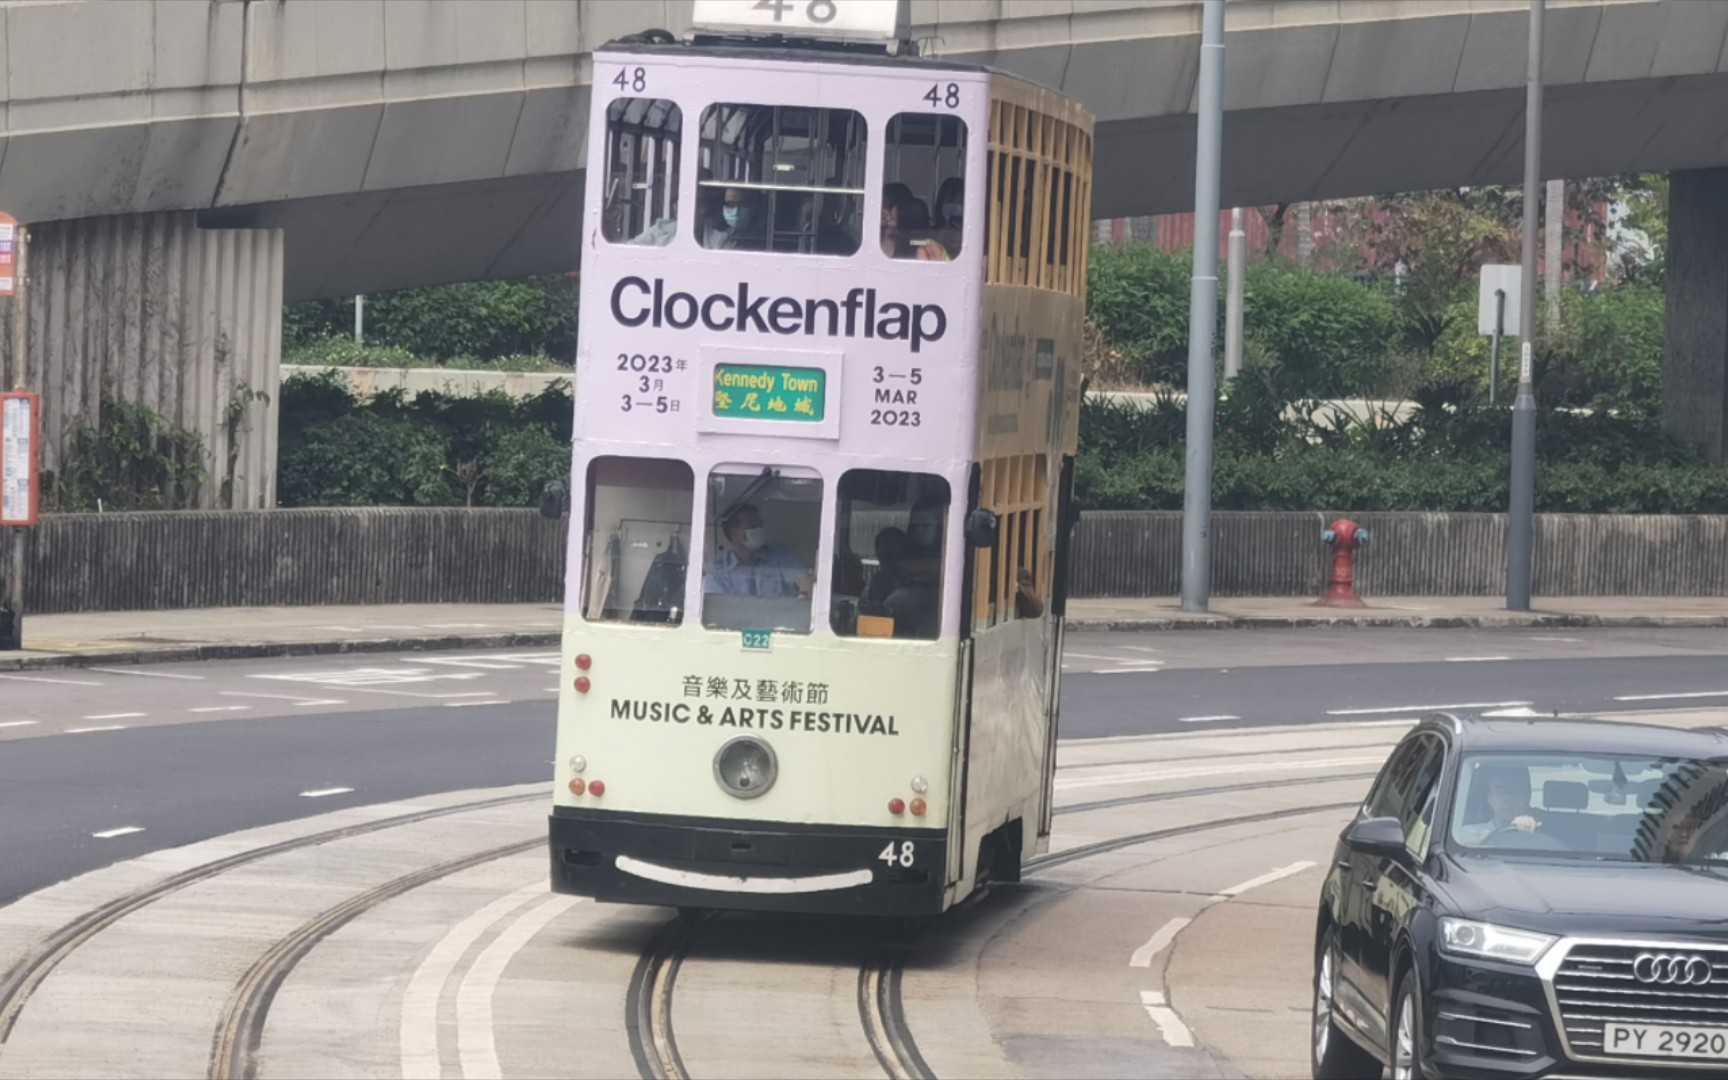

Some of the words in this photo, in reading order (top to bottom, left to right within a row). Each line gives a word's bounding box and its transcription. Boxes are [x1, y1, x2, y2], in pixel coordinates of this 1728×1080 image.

[611, 66, 646, 93] 48
[922, 82, 960, 109] 48
[610, 275, 948, 352] Clockenflap
[617, 353, 688, 373] 2023年
[638, 375, 664, 393] 3月
[781, 372, 818, 393] Town
[874, 388, 918, 405] MAR
[870, 408, 921, 427] 2023
[743, 632, 769, 648] C22
[681, 674, 829, 705] 音樂及藝術節
[610, 699, 691, 724] MUSIC
[696, 705, 714, 725] &
[718, 706, 784, 730] ARTS
[788, 710, 900, 736] FESTIVAL
[878, 841, 915, 868] 48
[1613, 1027, 1648, 1050] PY
[1657, 1030, 1726, 1055] 2920
